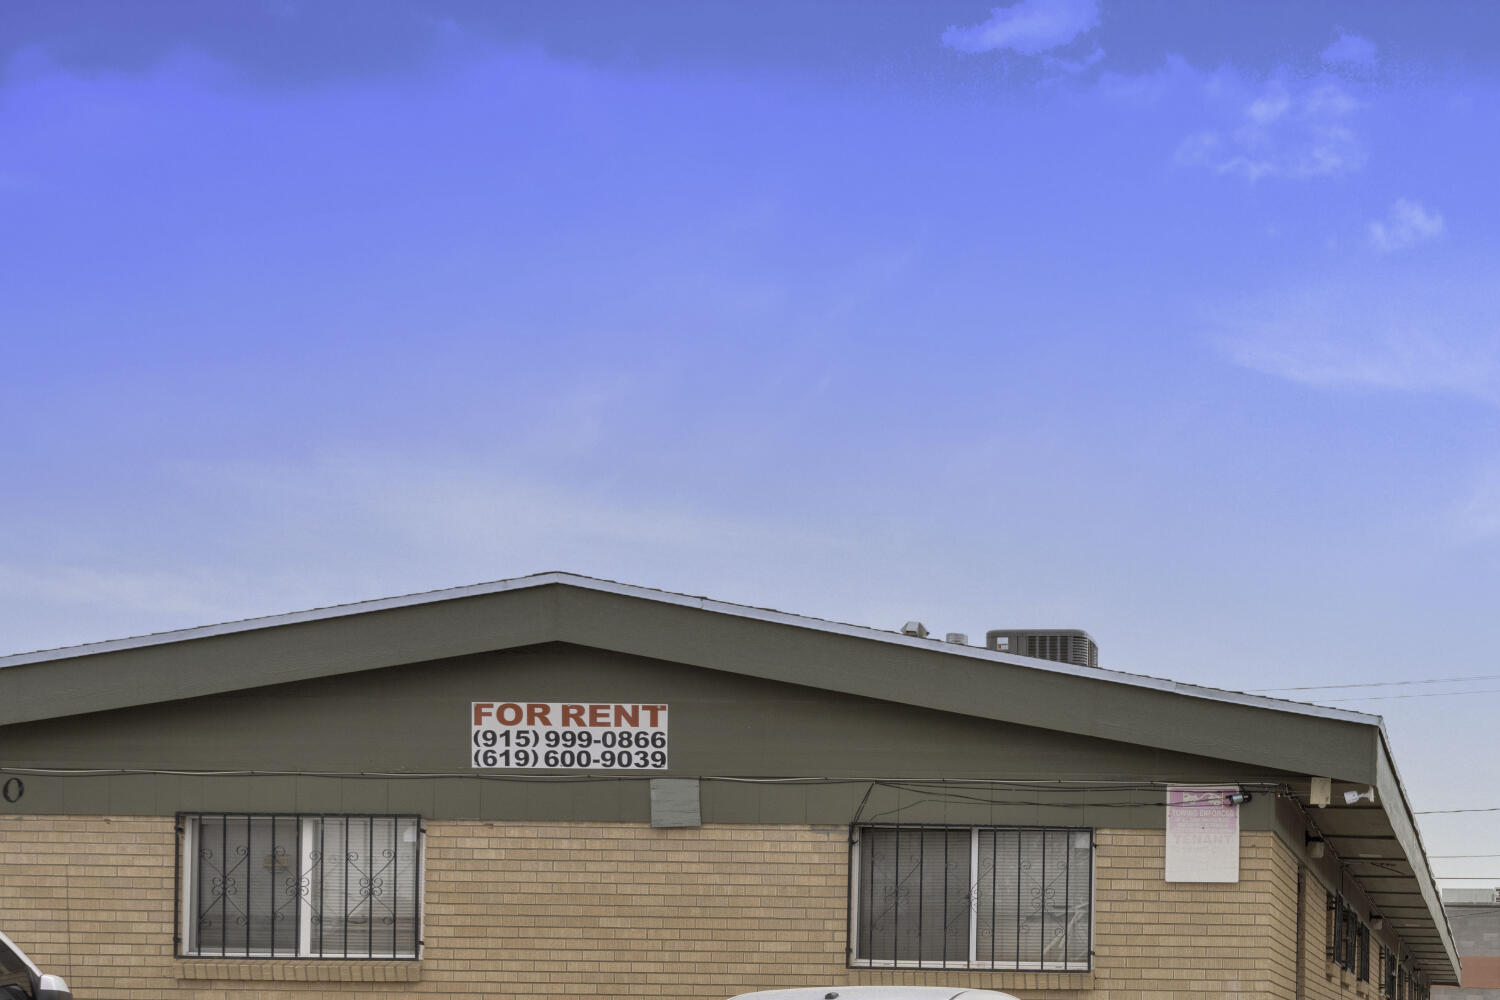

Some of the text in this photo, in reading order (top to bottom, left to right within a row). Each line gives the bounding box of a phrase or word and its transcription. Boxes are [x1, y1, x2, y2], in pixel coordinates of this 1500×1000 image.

[474, 703, 667, 728] FOR RENT
[473, 729, 667, 749] (915) 999-0866
[473, 749, 667, 768] (619) 600-9039
